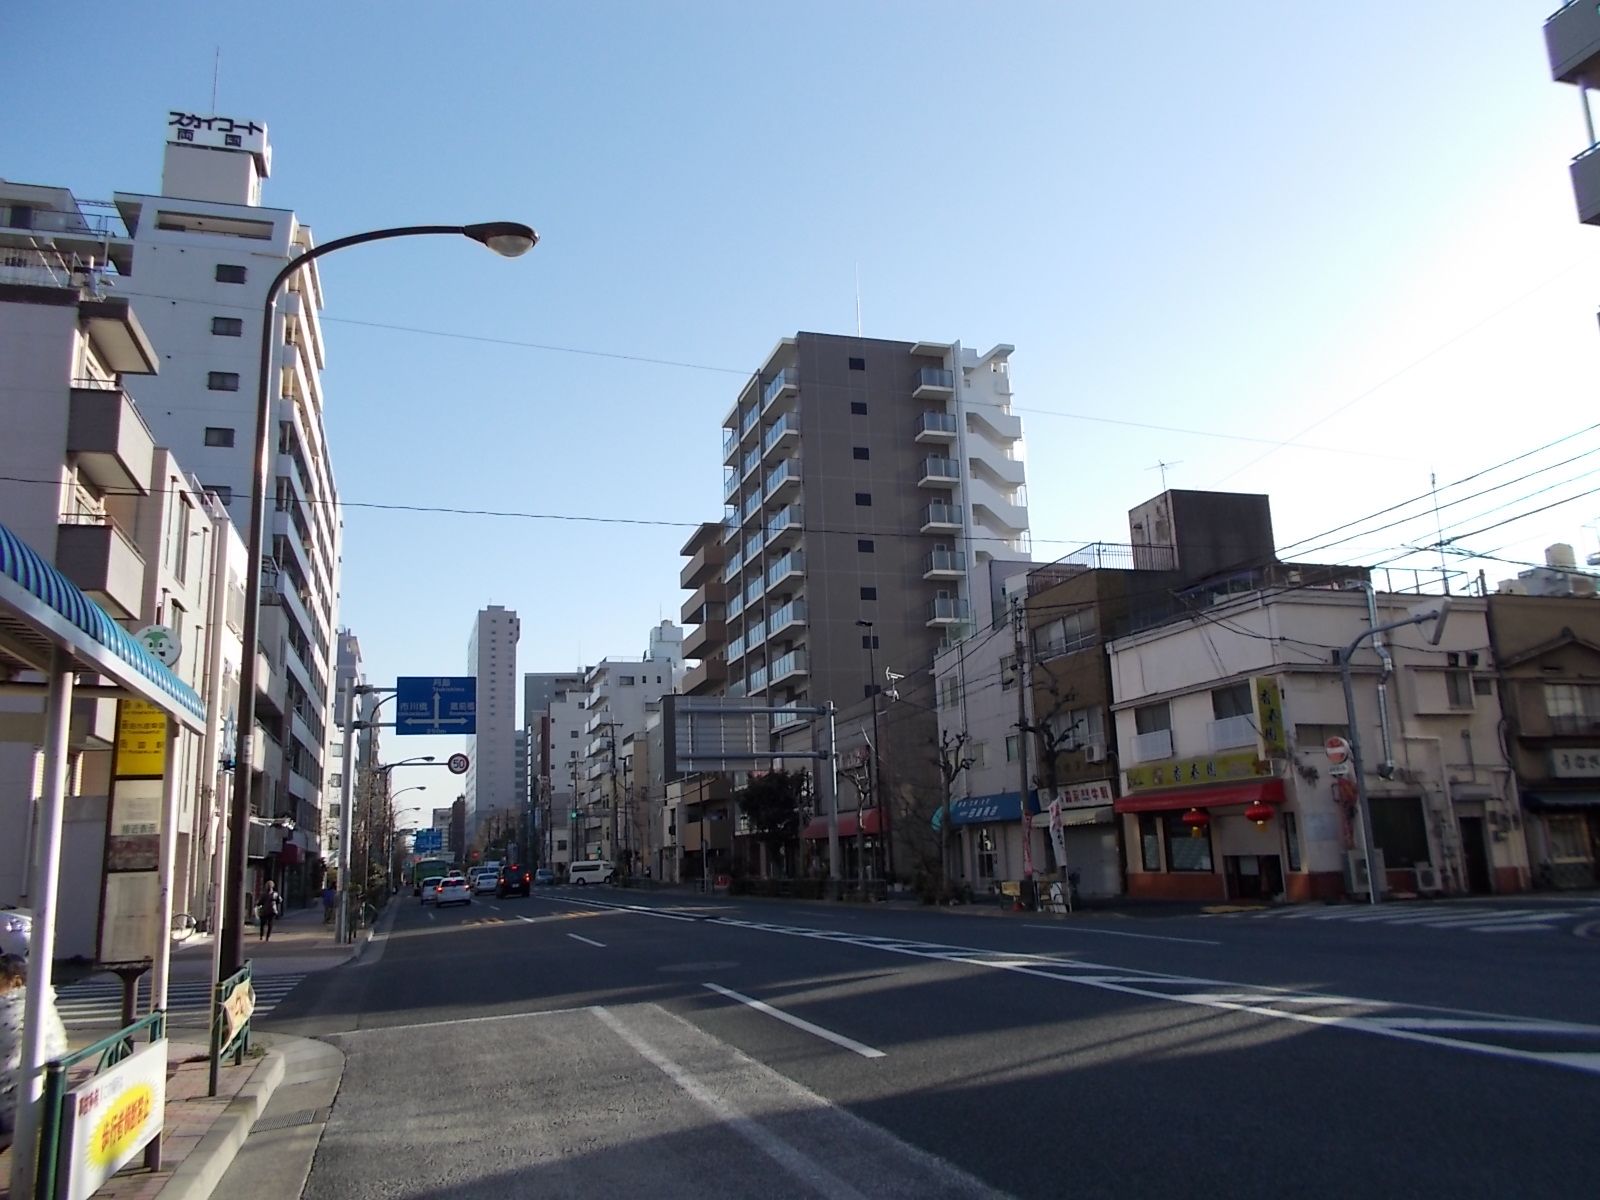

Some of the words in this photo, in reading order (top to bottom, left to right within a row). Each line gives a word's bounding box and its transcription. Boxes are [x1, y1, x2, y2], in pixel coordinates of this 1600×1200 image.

[168, 111, 264, 135] スカイコート
[177, 128, 242, 147] 両国
[453, 759, 465, 769] 50
